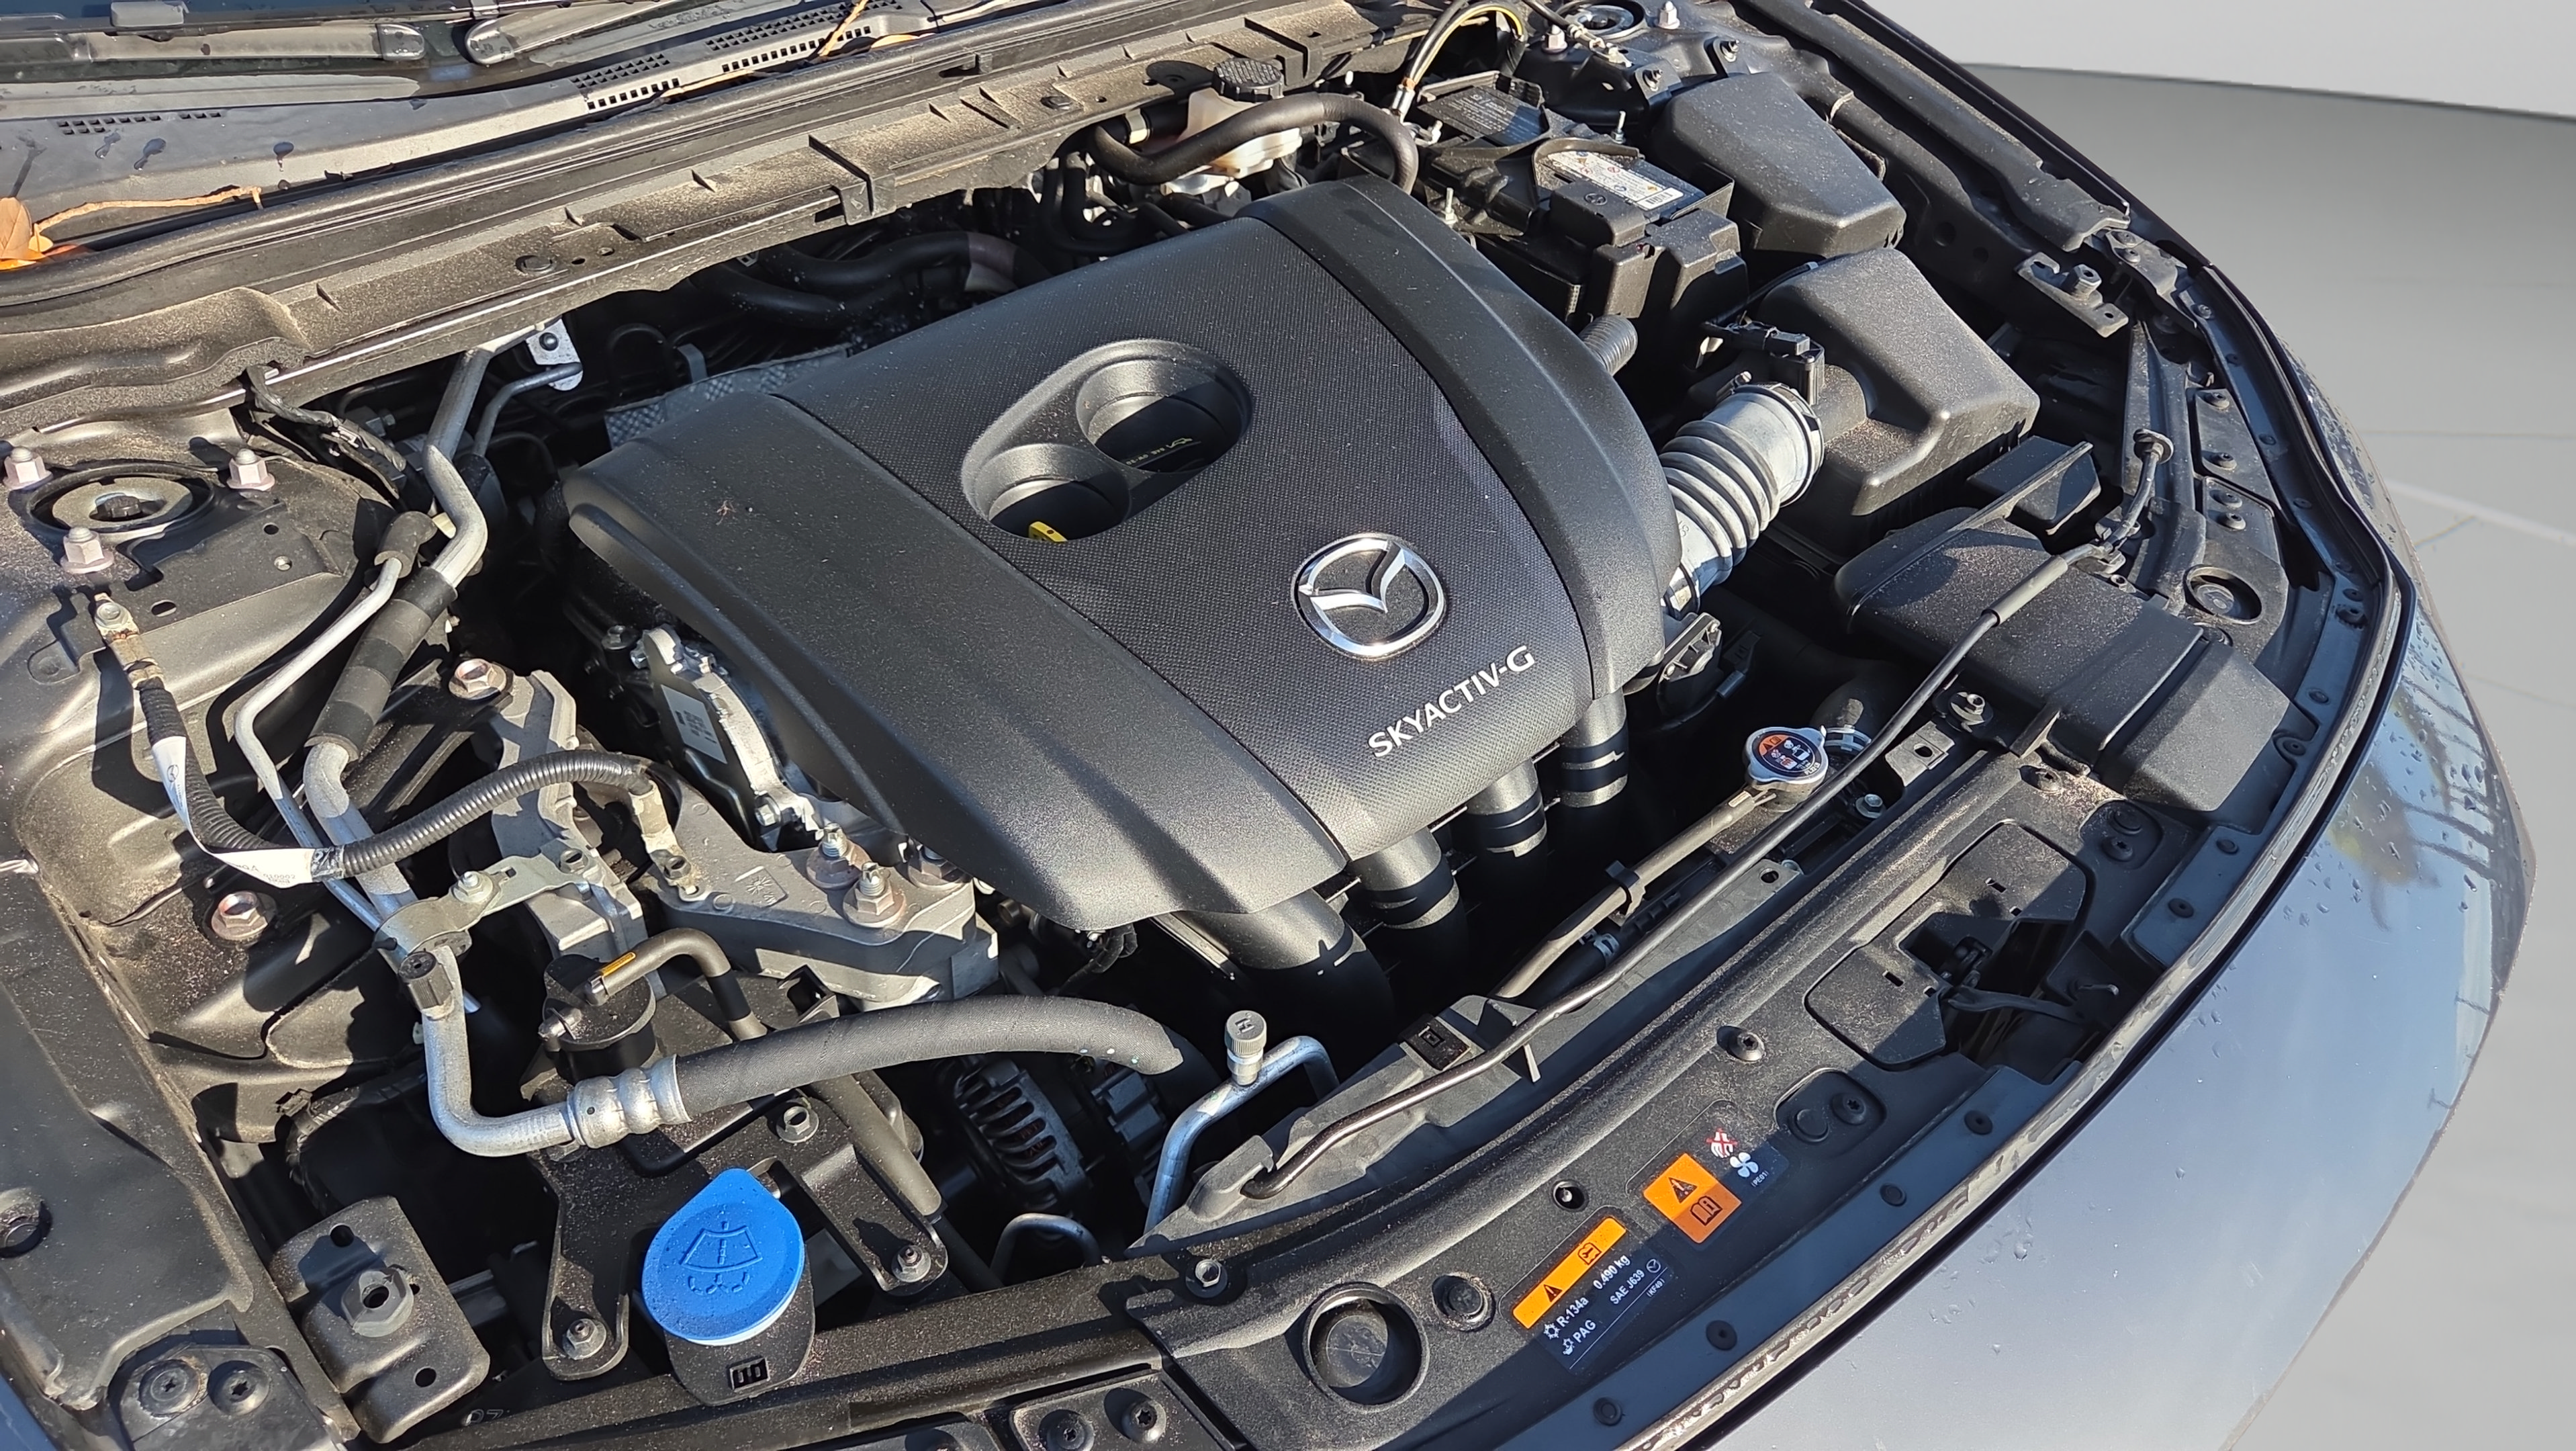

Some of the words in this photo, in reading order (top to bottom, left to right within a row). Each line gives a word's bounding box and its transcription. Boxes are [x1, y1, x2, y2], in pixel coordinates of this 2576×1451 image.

[1367, 645, 1535, 758] SKYACTIV-G
[1234, 1017, 1254, 1033] H
[1556, 1297, 1589, 1327] R-134a
[1593, 1265, 1618, 1289] 0.490
[1614, 1255, 1630, 1269] kg
[1573, 1319, 1596, 1343] PAG
[1610, 1285, 1629, 1305] SAE
[1626, 1270, 1645, 1289] J639
